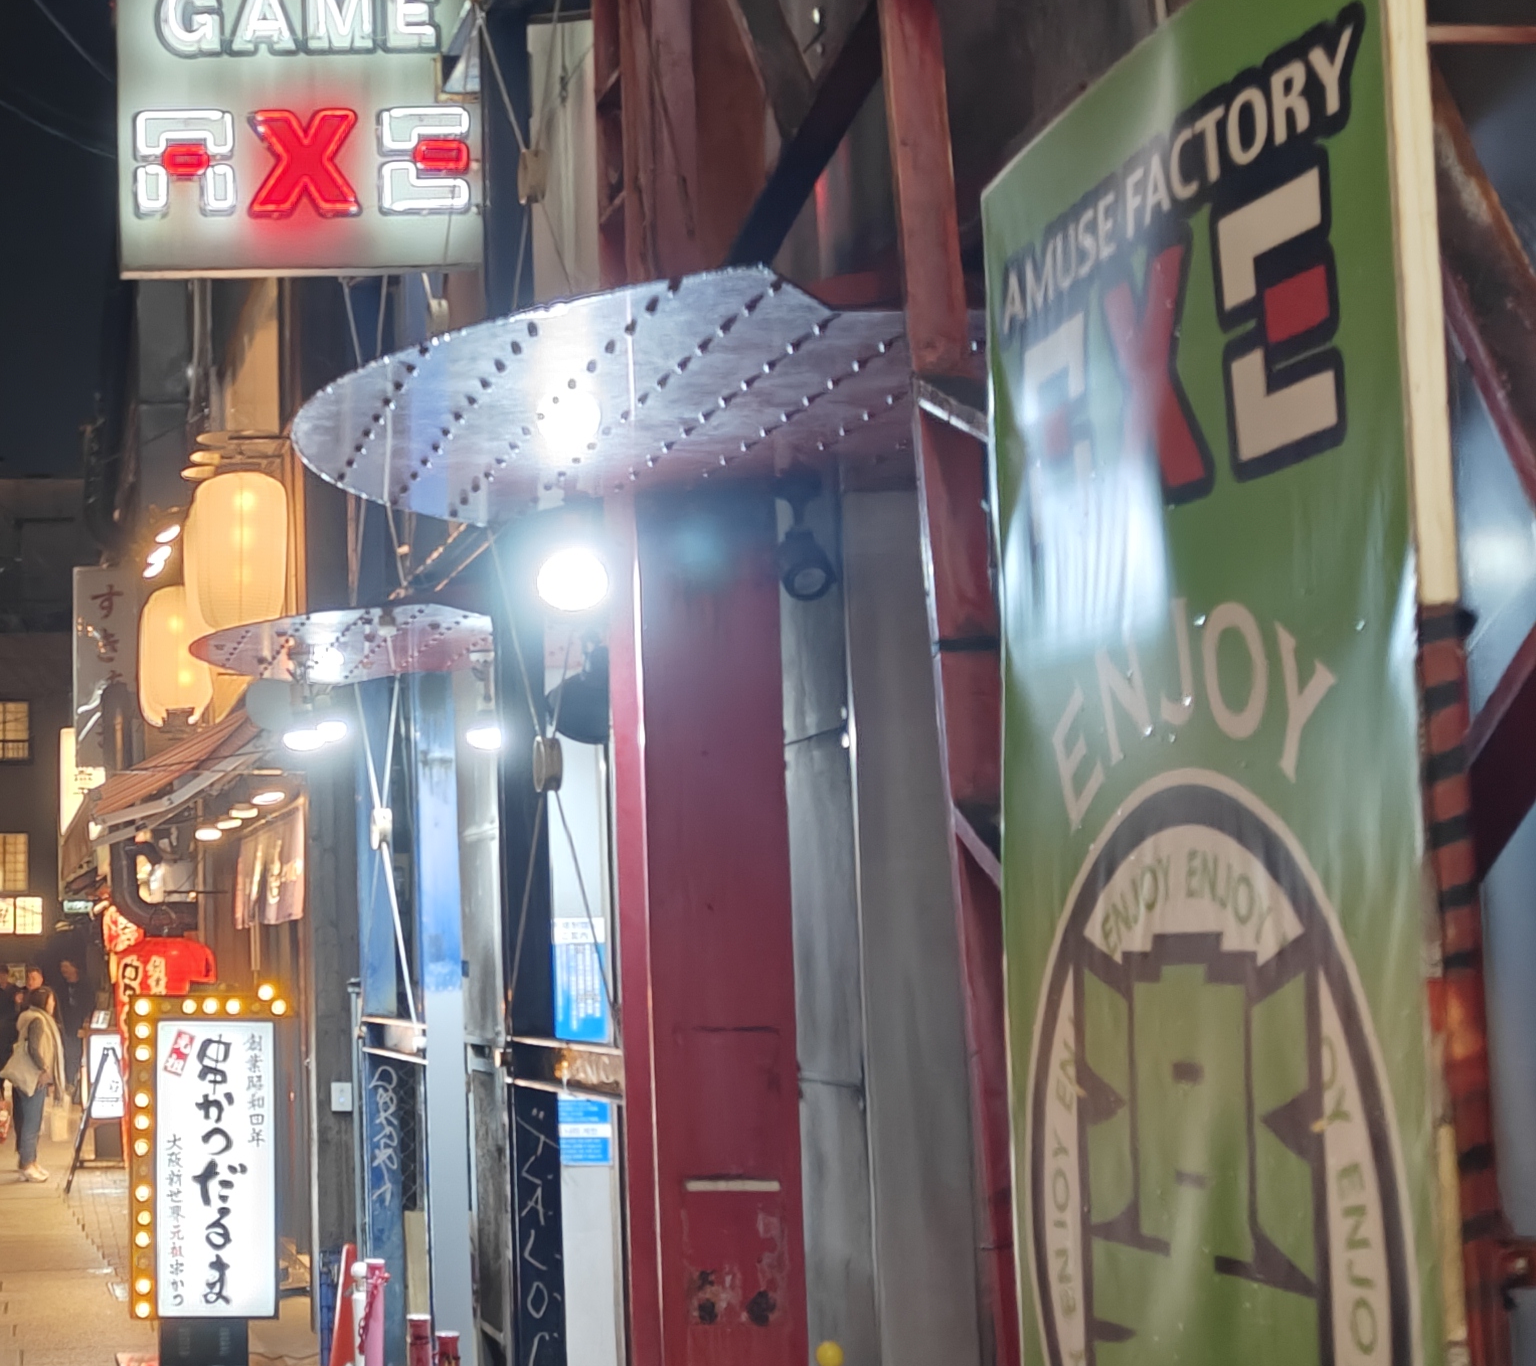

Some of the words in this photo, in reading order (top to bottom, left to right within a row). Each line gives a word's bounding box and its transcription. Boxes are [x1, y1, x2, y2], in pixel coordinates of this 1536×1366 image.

[1002, 189, 1118, 337] AMUSE
[1125, 21, 1356, 241] FACTORY
[1051, 597, 1338, 836] ENJOY
[1100, 853, 1172, 956] ENJOY
[191, 1033, 249, 1306] 串かつだるま
